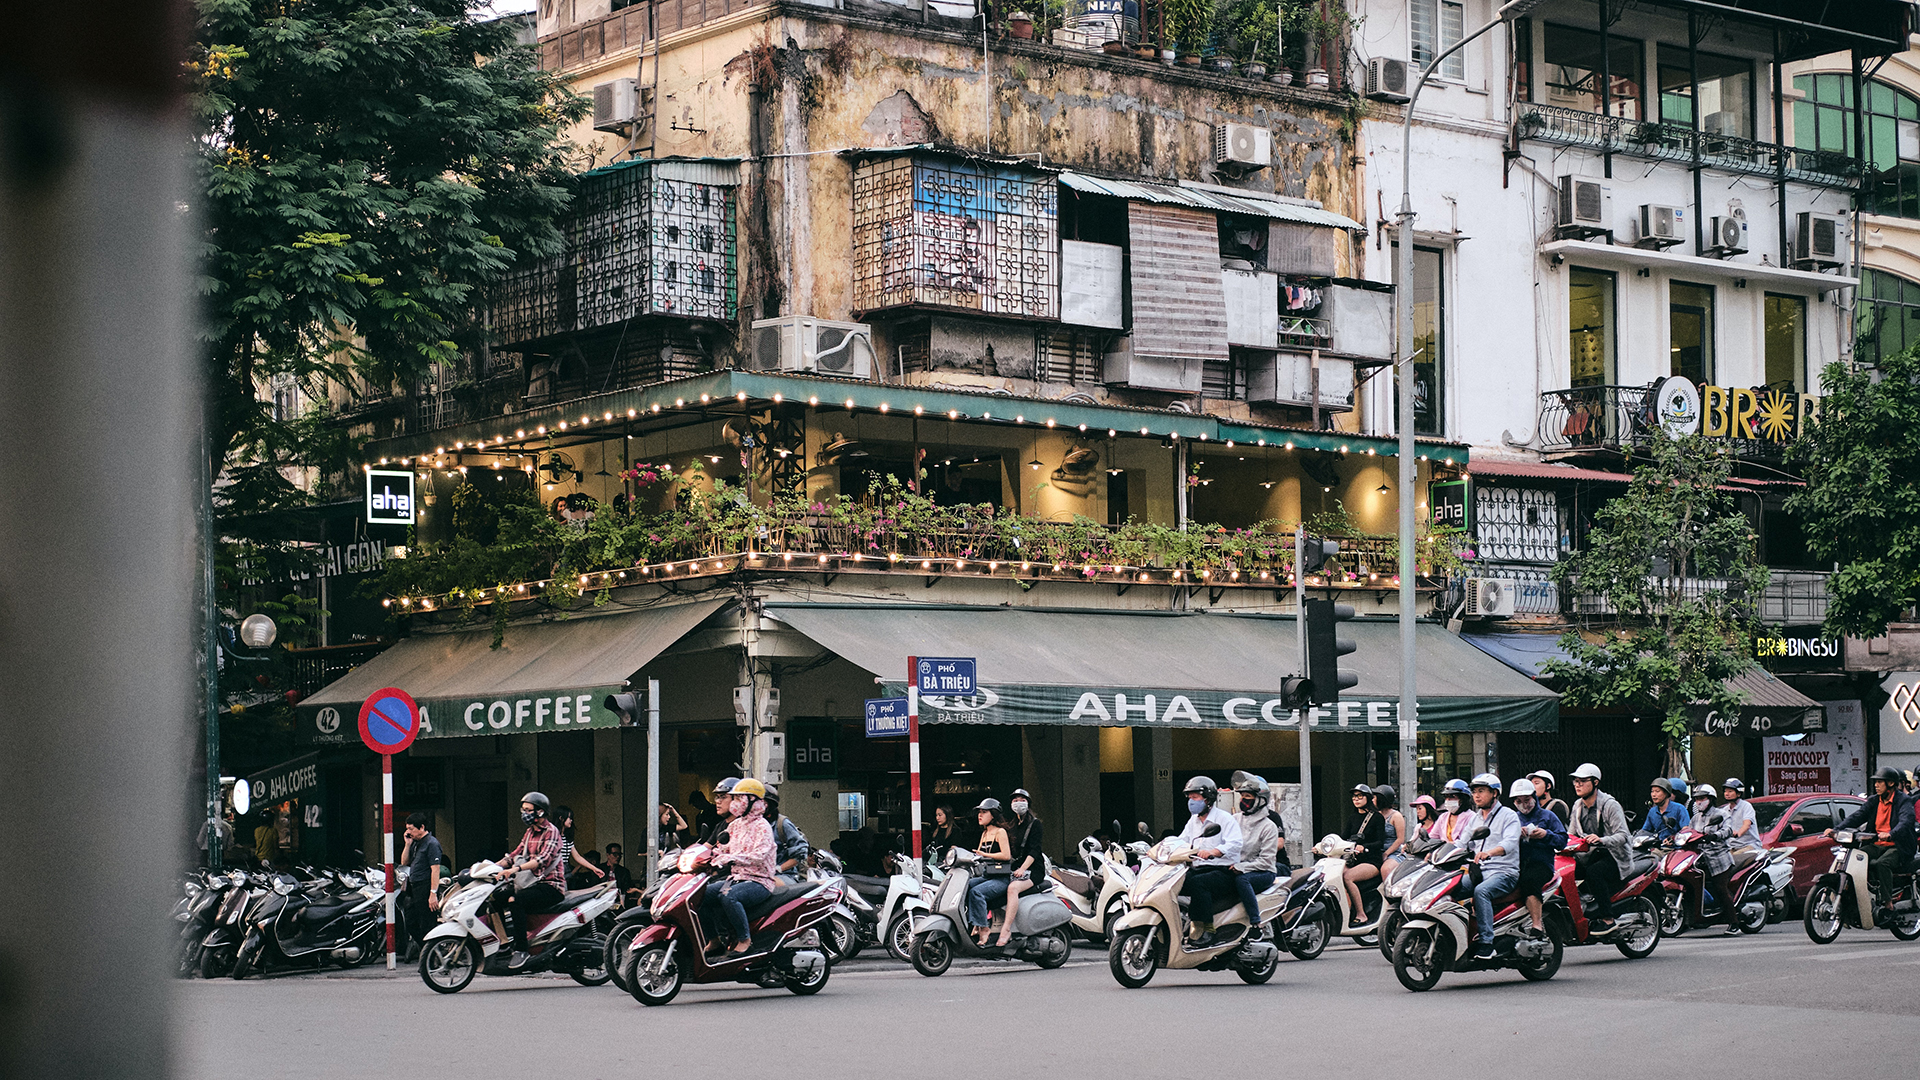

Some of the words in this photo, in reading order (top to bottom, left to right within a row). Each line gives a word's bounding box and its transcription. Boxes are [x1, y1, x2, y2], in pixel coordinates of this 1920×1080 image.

[373, 485, 409, 510] aha
[1435, 497, 1463, 519] aha
[938, 662, 955, 673] PHỐ
[923, 673, 938, 690] BÀ
[940, 673, 970, 692] TRIỆU
[464, 694, 592, 731] COFFEE
[880, 701, 894, 713] PHỐ
[938, 711, 952, 722] BÀ
[1068, 692, 1202, 723] AHA
[321, 710, 335, 730] 42
[1751, 716, 1771, 730] 40
[796, 738, 832, 763] aha
[1768, 751, 1830, 765] PHOTOCOPY
[270, 776, 288, 800] AHA
[288, 764, 317, 794] COFFEE
[404, 774, 438, 795] aha
[1781, 770, 1796, 781] Sang
[811, 790, 821, 799] 40
[1814, 784, 1829, 793] Trung
[304, 804, 320, 828] 42
